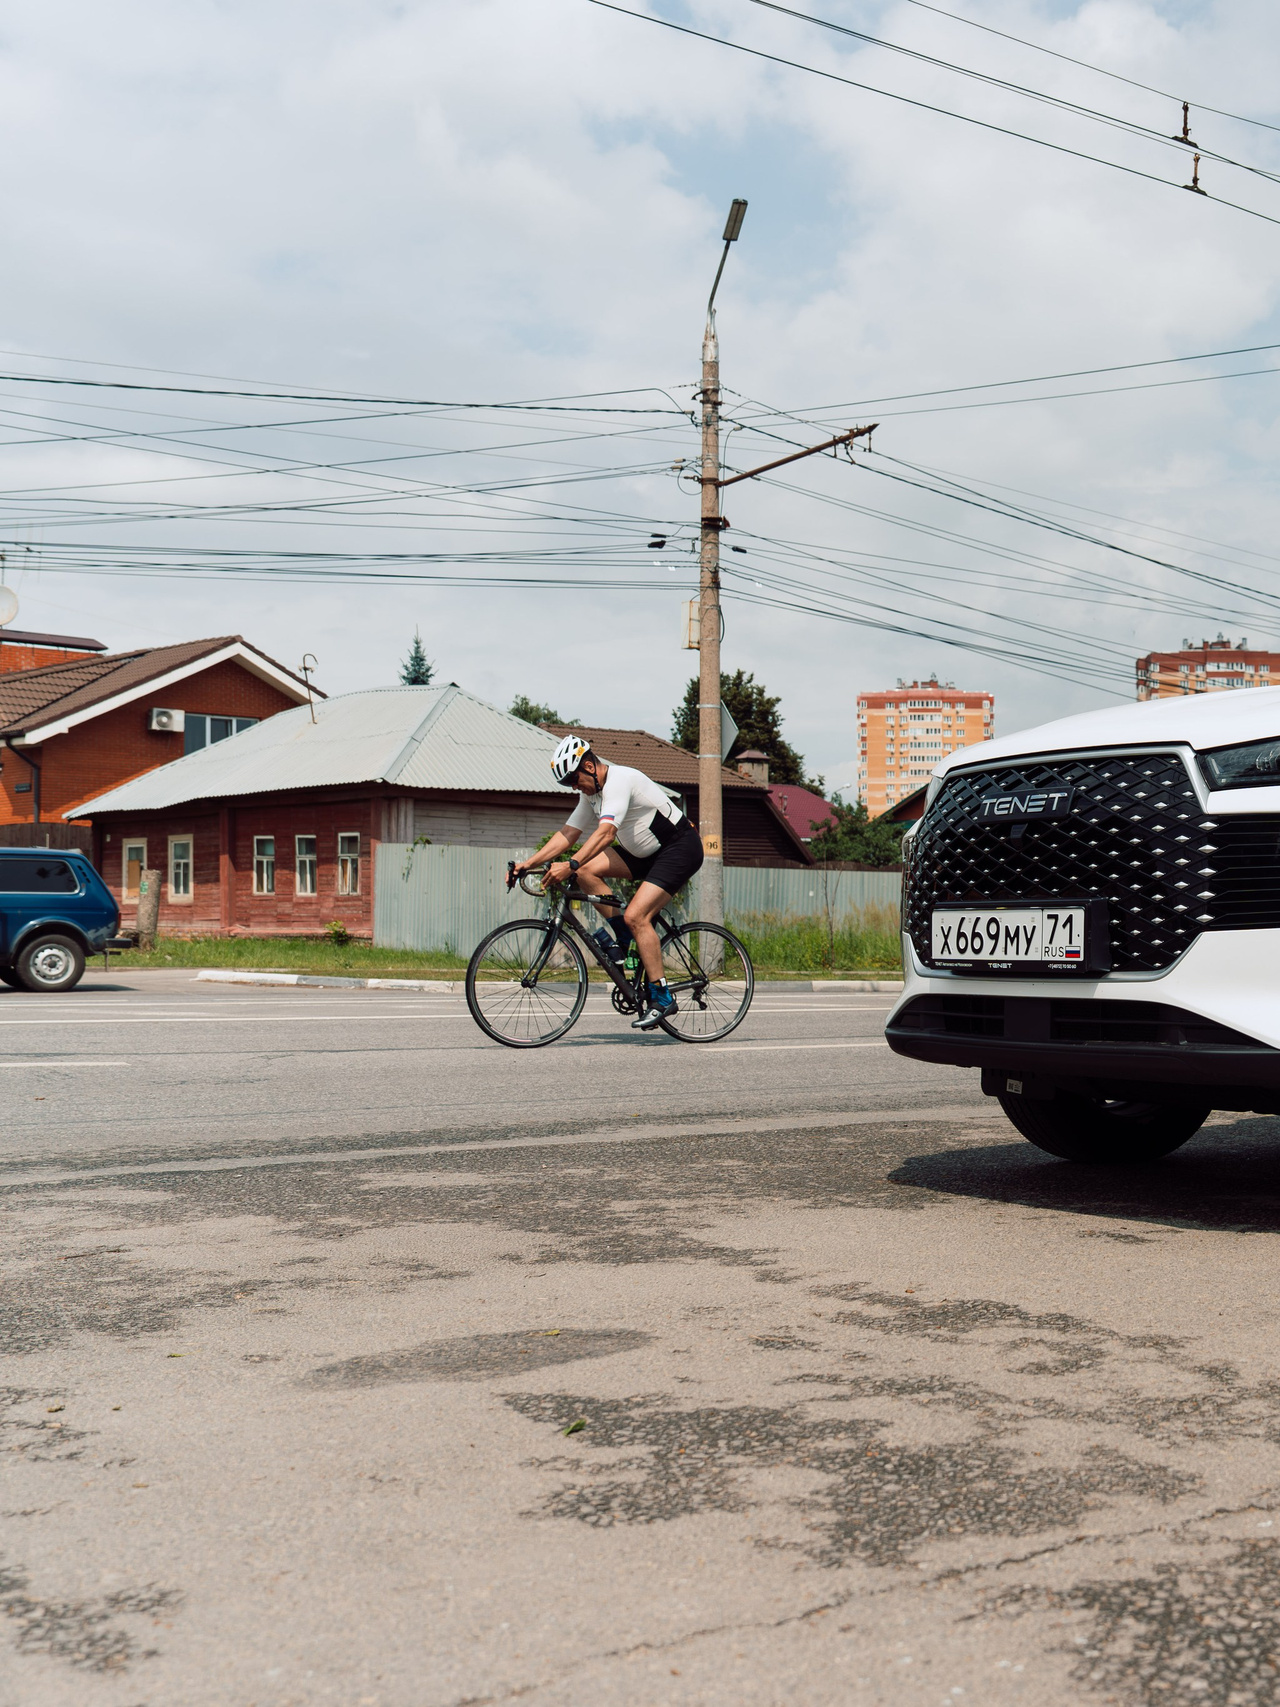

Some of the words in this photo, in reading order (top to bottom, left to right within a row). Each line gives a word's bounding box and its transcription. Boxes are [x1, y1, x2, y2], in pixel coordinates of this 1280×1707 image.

[981, 792, 1068, 816] TENET
[706, 841, 718, 850] 96
[1046, 913, 1074, 945] 71
[1043, 946, 1065, 958] RUS
